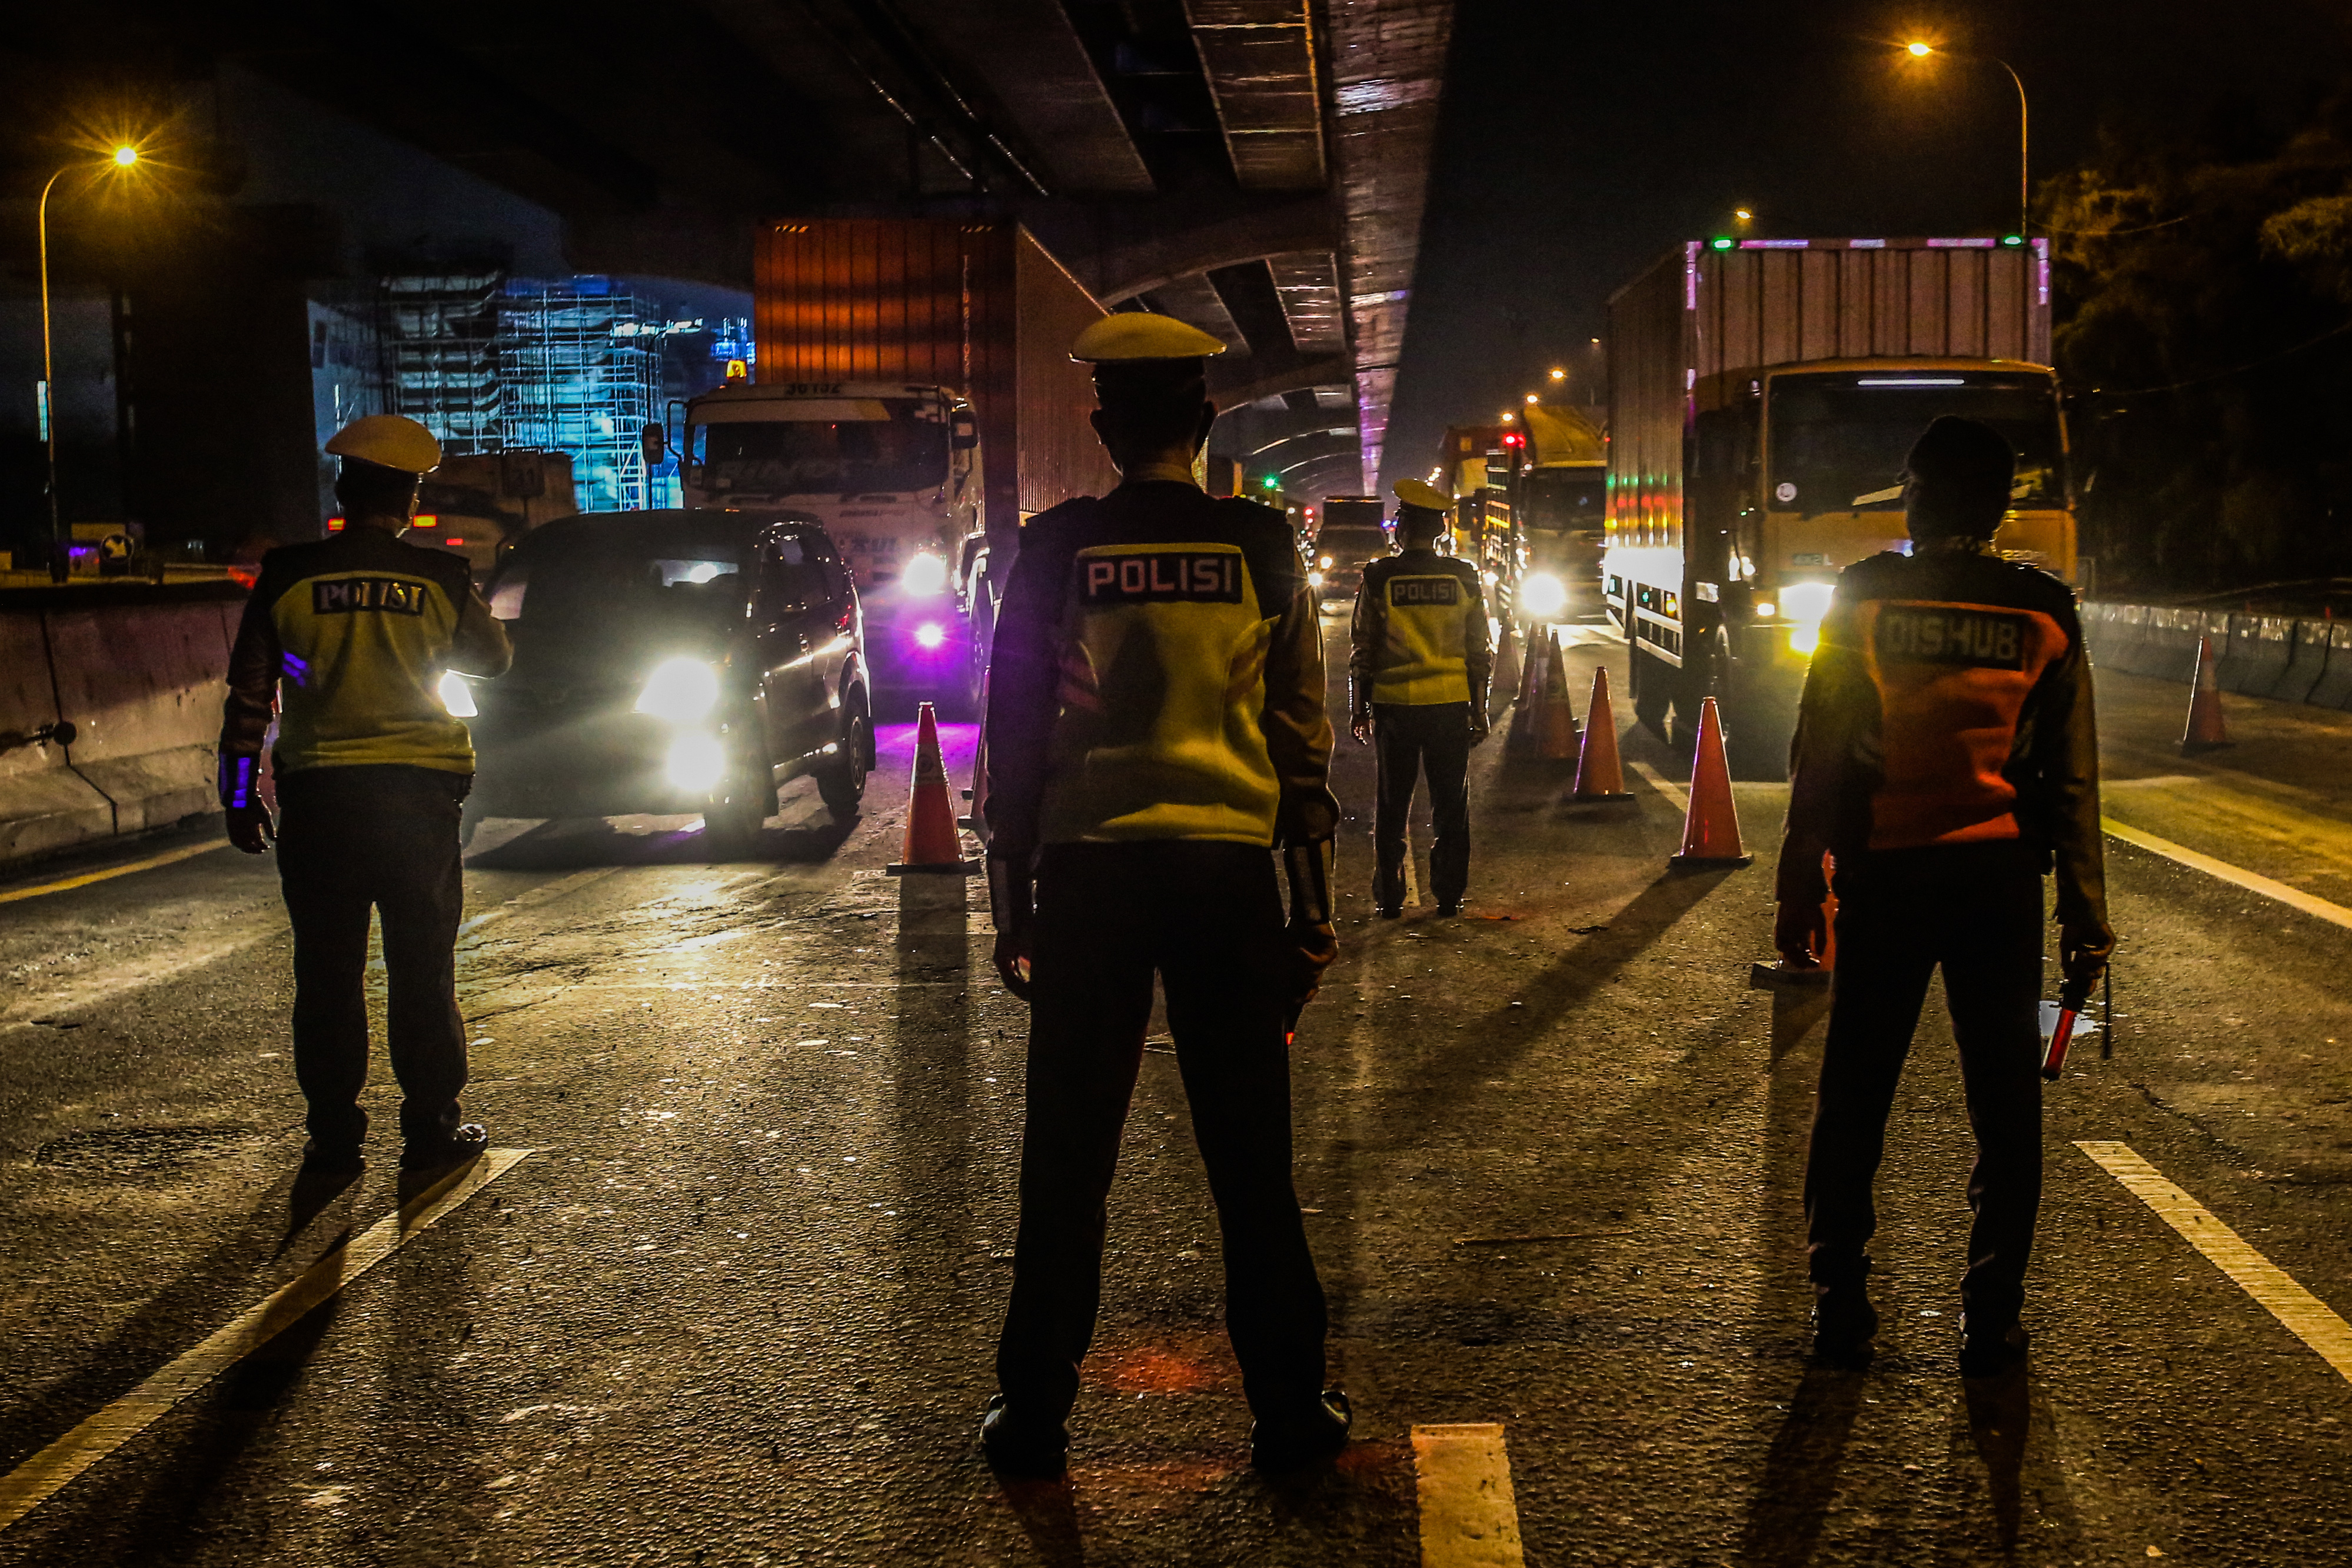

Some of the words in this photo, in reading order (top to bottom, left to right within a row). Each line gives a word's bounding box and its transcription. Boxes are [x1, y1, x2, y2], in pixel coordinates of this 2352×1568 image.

[1088, 558, 1232, 597] POLISI
[1393, 582, 1455, 601] POLISI
[1883, 614, 2018, 661] DISHUB
